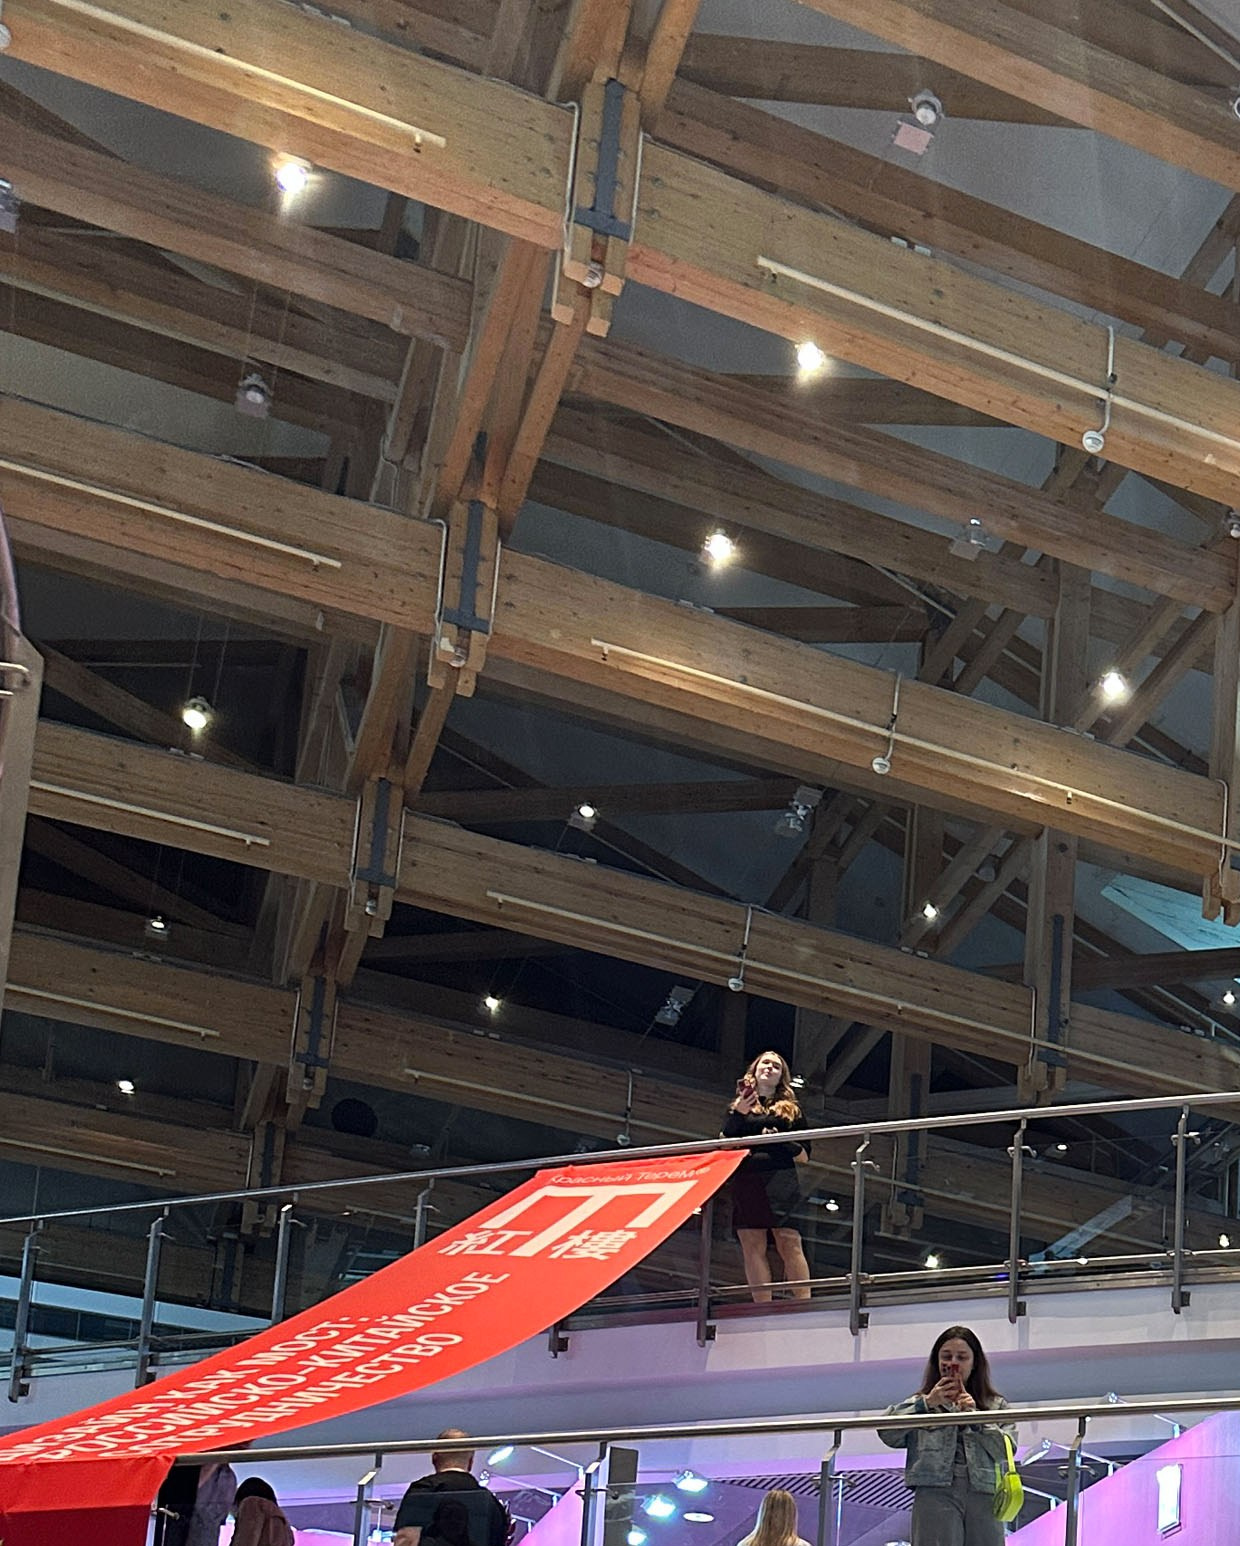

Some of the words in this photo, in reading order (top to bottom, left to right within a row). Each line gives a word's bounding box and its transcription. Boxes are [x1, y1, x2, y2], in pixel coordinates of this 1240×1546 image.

[29, 1270, 512, 1461] РОССИЙСКО-КИТАЙСКОЕ
[97, 1331, 464, 1458] СОТРУДНИЧЕСТВО
[153, 1366, 262, 1402] КАК
[242, 1316, 370, 1371] МОСТ:
